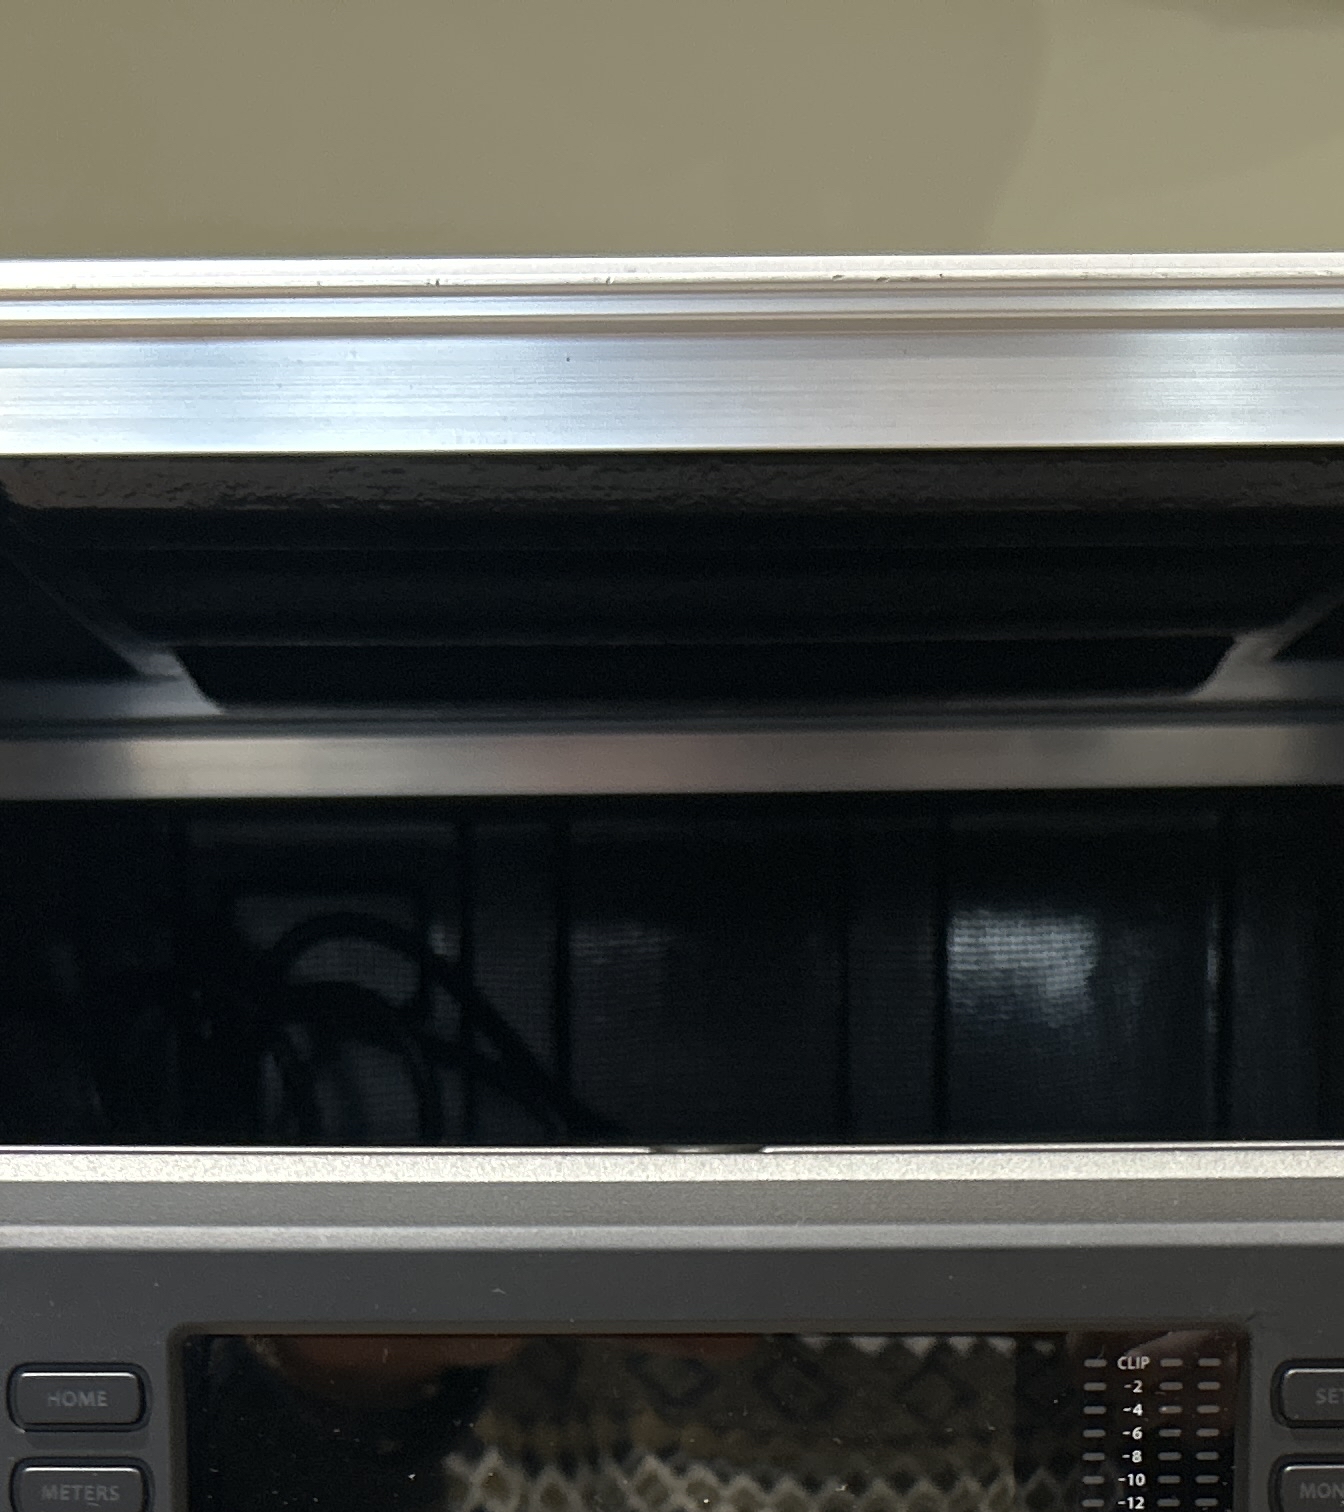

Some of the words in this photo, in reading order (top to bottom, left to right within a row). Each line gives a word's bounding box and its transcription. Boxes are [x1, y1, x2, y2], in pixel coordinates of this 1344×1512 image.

[1118, 1356, 1150, 1369] CLIP
[1125, 1380, 1142, 1392] -2
[47, 1390, 107, 1407] HOME
[1123, 1404, 1143, 1415] -4
[1123, 1427, 1142, 1439] -6
[1123, 1450, 1142, 1463] -8
[1118, 1474, 1145, 1486] -10
[41, 1484, 121, 1501] METERS
[1118, 1497, 1144, 1509] -12
